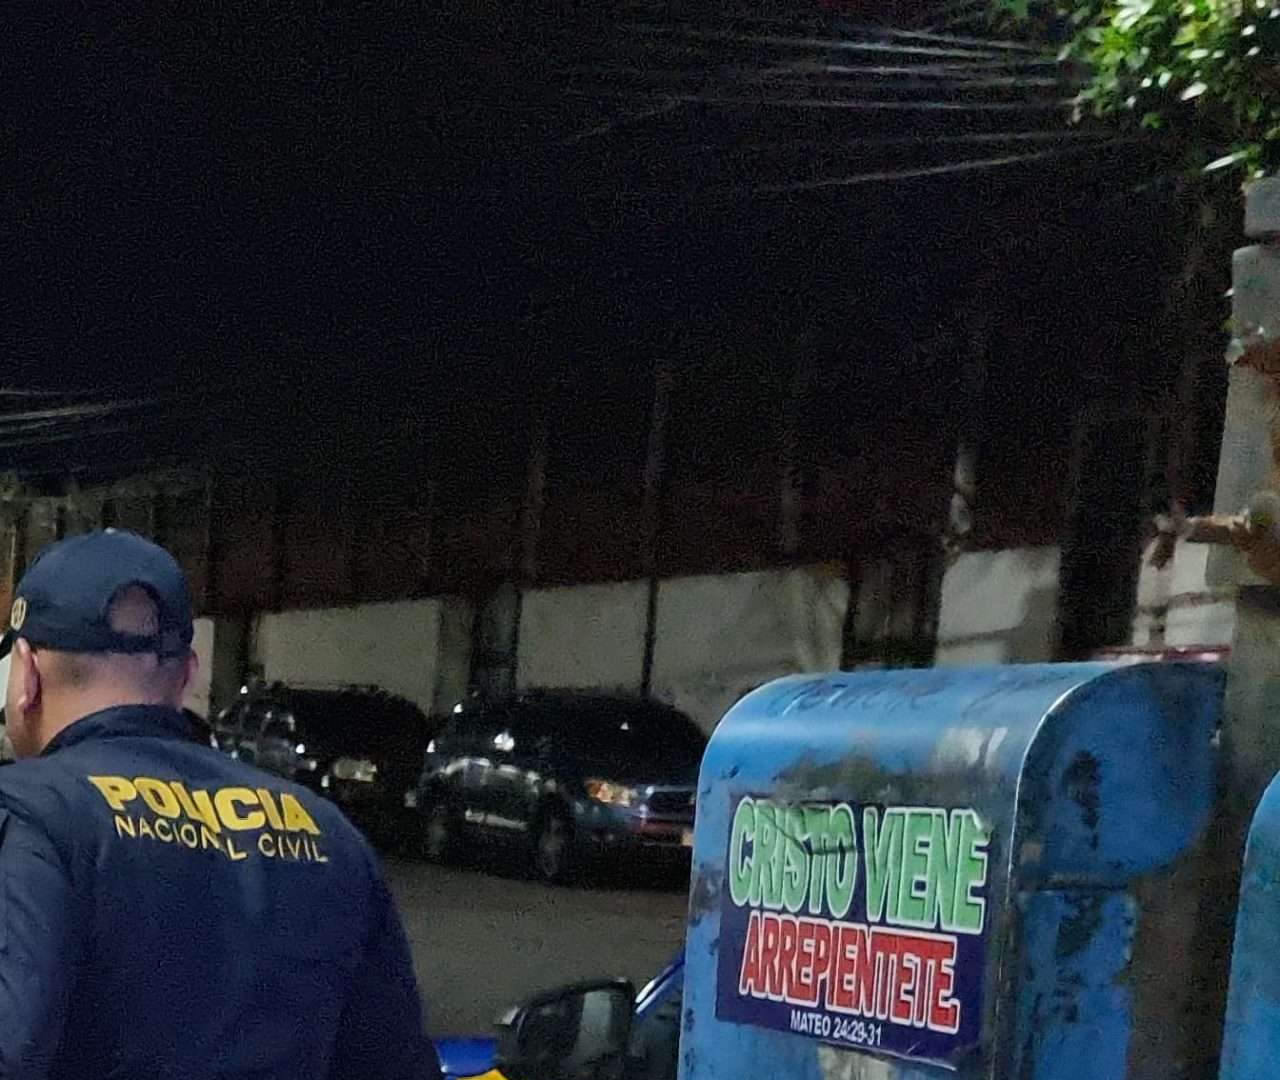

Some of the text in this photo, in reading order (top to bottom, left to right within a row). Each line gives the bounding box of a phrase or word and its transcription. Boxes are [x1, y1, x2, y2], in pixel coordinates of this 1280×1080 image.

[88, 775, 321, 834] POLICIA
[114, 815, 329, 862] NACIONL CIVIL
[729, 797, 988, 934] CRISTO VIENE
[739, 911, 960, 1034] ARREPIENTETE
[790, 1009, 882, 1046] MATEO 24:29-31
